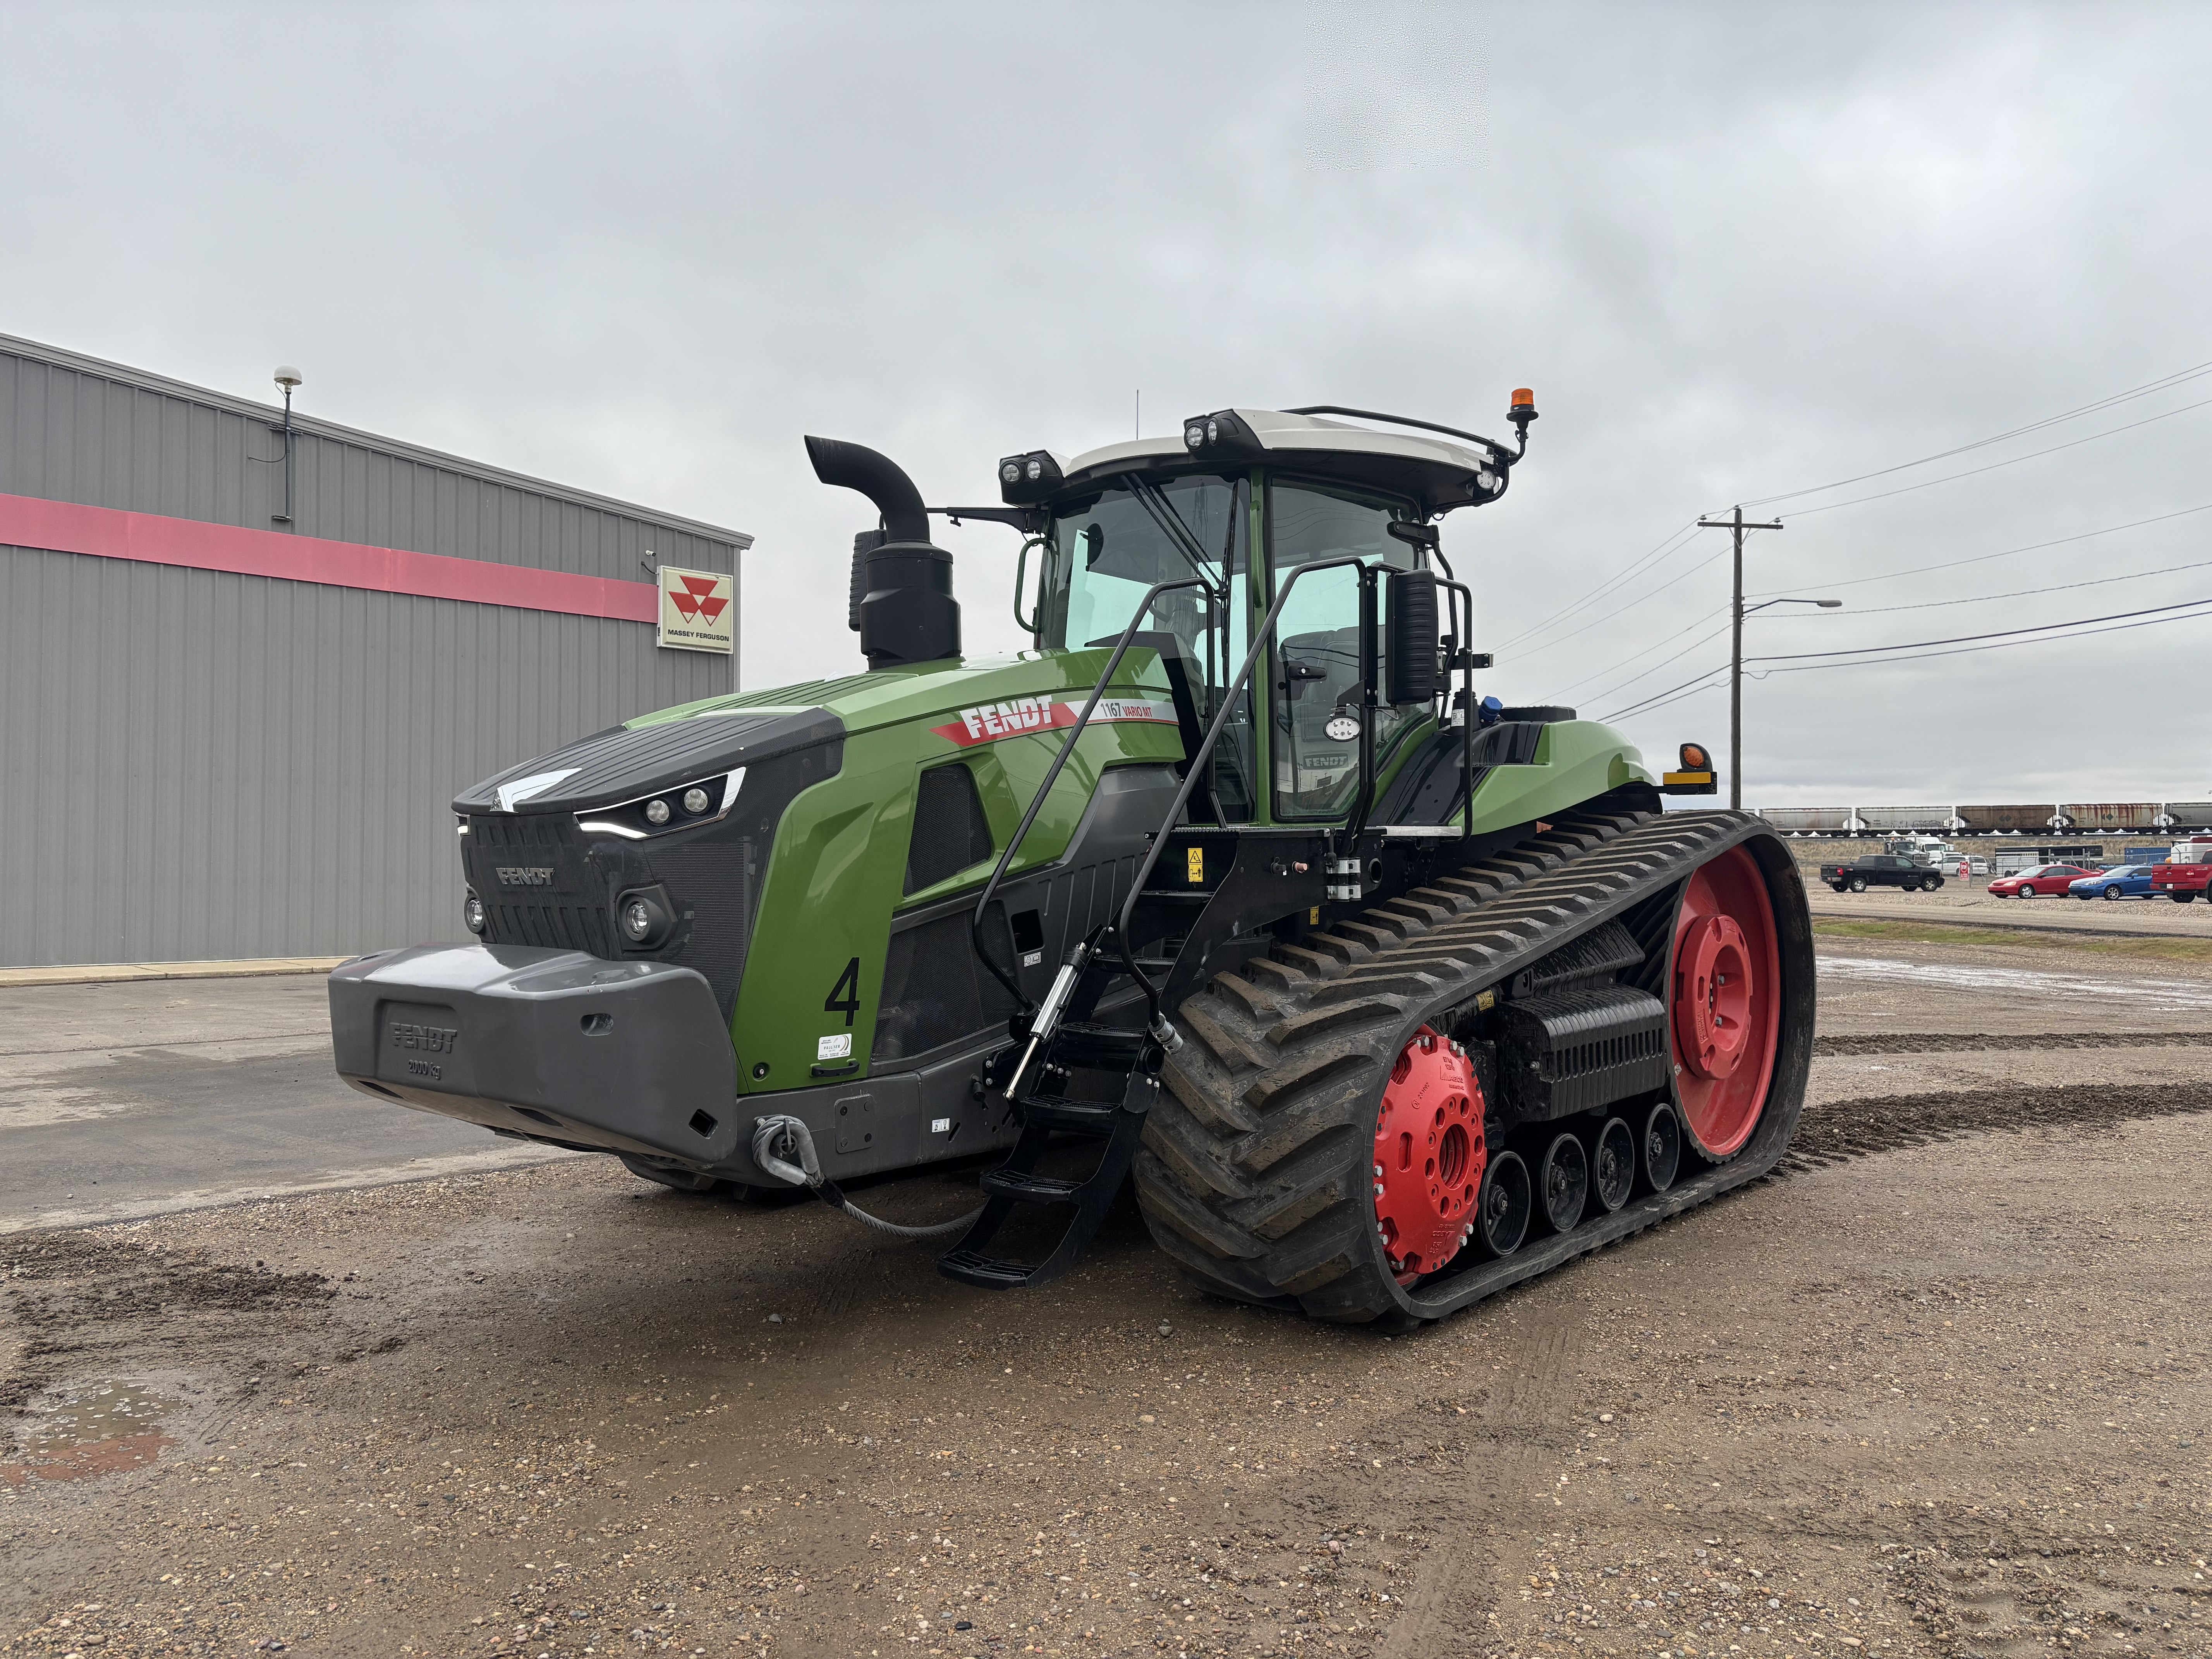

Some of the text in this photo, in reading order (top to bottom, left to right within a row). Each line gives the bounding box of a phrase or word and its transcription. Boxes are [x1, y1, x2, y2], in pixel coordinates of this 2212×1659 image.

[696, 632, 729, 641] FERGUSON
[959, 695, 1053, 739] FENDT
[1101, 703, 1152, 717] 1167 VARIO MT
[1305, 756, 1347, 767] FENDT
[496, 868, 555, 885] FENDT
[824, 957, 860, 1026] 4
[389, 1022, 457, 1053] FENDT
[409, 1060, 441, 1080] 2000 kg
